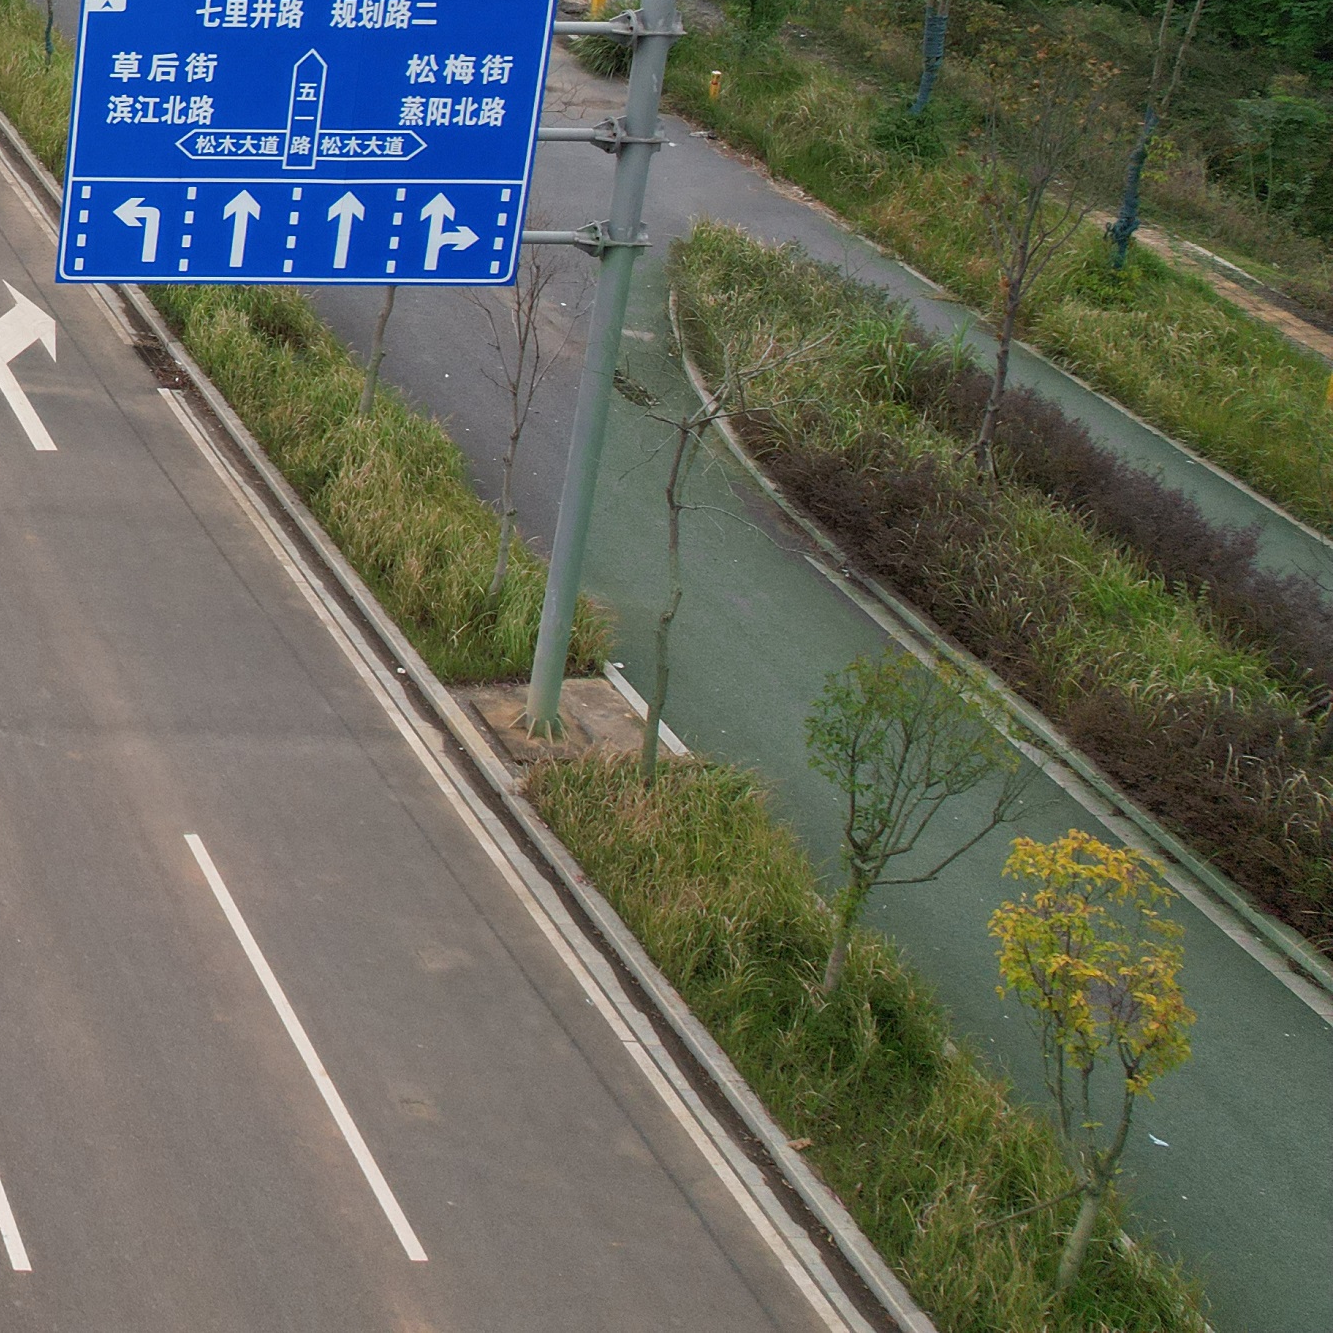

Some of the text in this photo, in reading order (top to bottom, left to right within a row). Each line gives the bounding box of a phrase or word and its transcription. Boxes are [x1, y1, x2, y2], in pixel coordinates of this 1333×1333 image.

[109, 52, 513, 85] 草后街 松梅街
[106, 95, 506, 127] 滨江北路 蒸阳北路
[290, 83, 318, 155] 五一路
[196, 135, 280, 156] 松木大道
[321, 135, 405, 156] 松木大道
